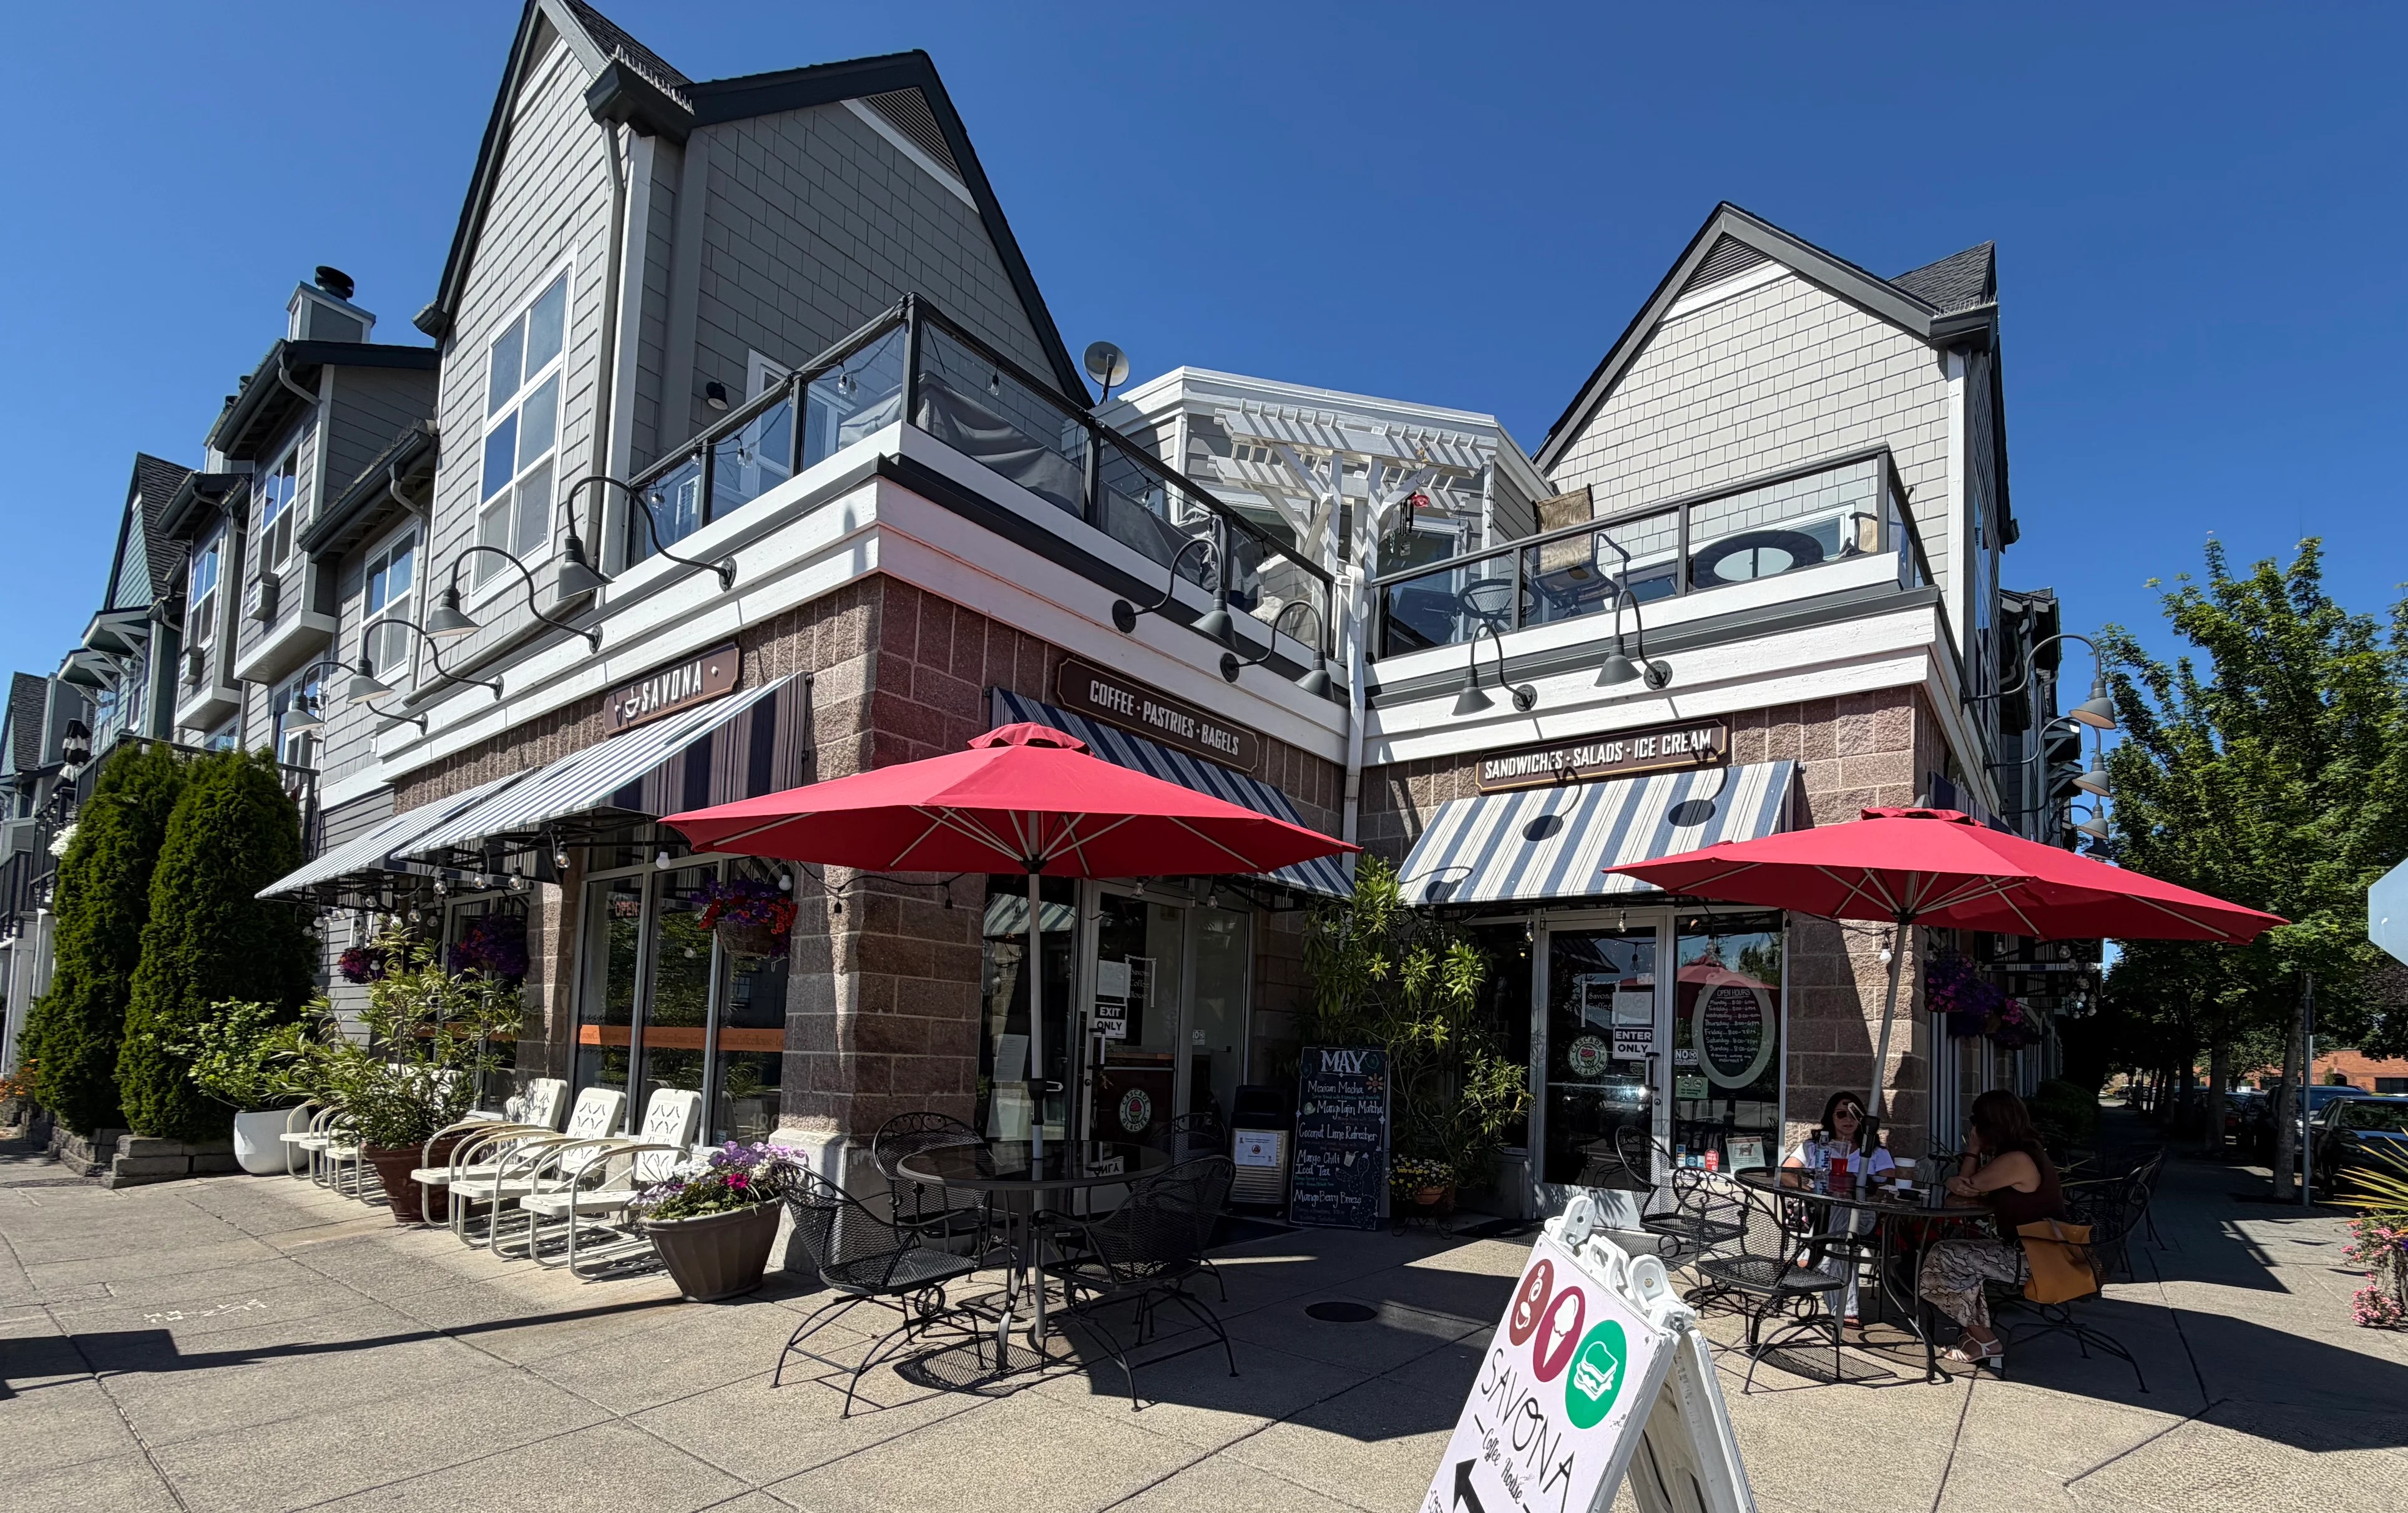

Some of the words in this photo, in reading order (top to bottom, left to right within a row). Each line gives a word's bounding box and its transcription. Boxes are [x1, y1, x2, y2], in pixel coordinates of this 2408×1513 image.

[642, 660, 702, 712] SAVONA
[1089, 680, 1134, 716] COFFEE
[1142, 700, 1195, 738] PASTRIES
[1201, 723, 1239, 756] BAGELS
[1485, 750, 1563, 780] SANDWICHES
[1573, 742, 1623, 767] SALADS
[1634, 737, 1657, 758] ICE
[1662, 729, 1712, 755] CREAM
[615, 901, 638, 917] OPEN
[1717, 989, 1731, 997] OPEN
[1732, 988, 1751, 996] HOURS
[1100, 1007, 1121, 1017] EXIT
[1097, 1021, 1122, 1031] ONLY
[1615, 1031, 1652, 1040] ENTER
[1571, 1037, 1604, 1054] CASCADE
[1618, 1044, 1648, 1053] ONLY
[1320, 1050, 1369, 1074] MAY
[1675, 1050, 1688, 1059] NO
[1574, 1060, 1605, 1075] GLACIER
[1308, 1080, 1336, 1093] Mexican
[1338, 1081, 1364, 1094] Mocha
[1122, 1090, 1150, 1105] CASCADE
[1358, 1100, 1384, 1115] Matcha
[1122, 1117, 1148, 1130] GLACIER
[1299, 1122, 1324, 1139] Coconut
[1327, 1124, 1344, 1141] Lime
[1346, 1125, 1378, 1142] Refresher
[1296, 1149, 1321, 1166] Mango
[1323, 1152, 1340, 1164] Chili
[1295, 1163, 1313, 1175] Iced
[1317, 1165, 1331, 1176] Tea
[1293, 1189, 1319, 1207] Mango
[1319, 1190, 1339, 1208] Berry
[1481, 1348, 1575, 1513] SAVONA
[1483, 1428, 1501, 1466] Coffee
[1501, 1457, 1523, 1504] House
